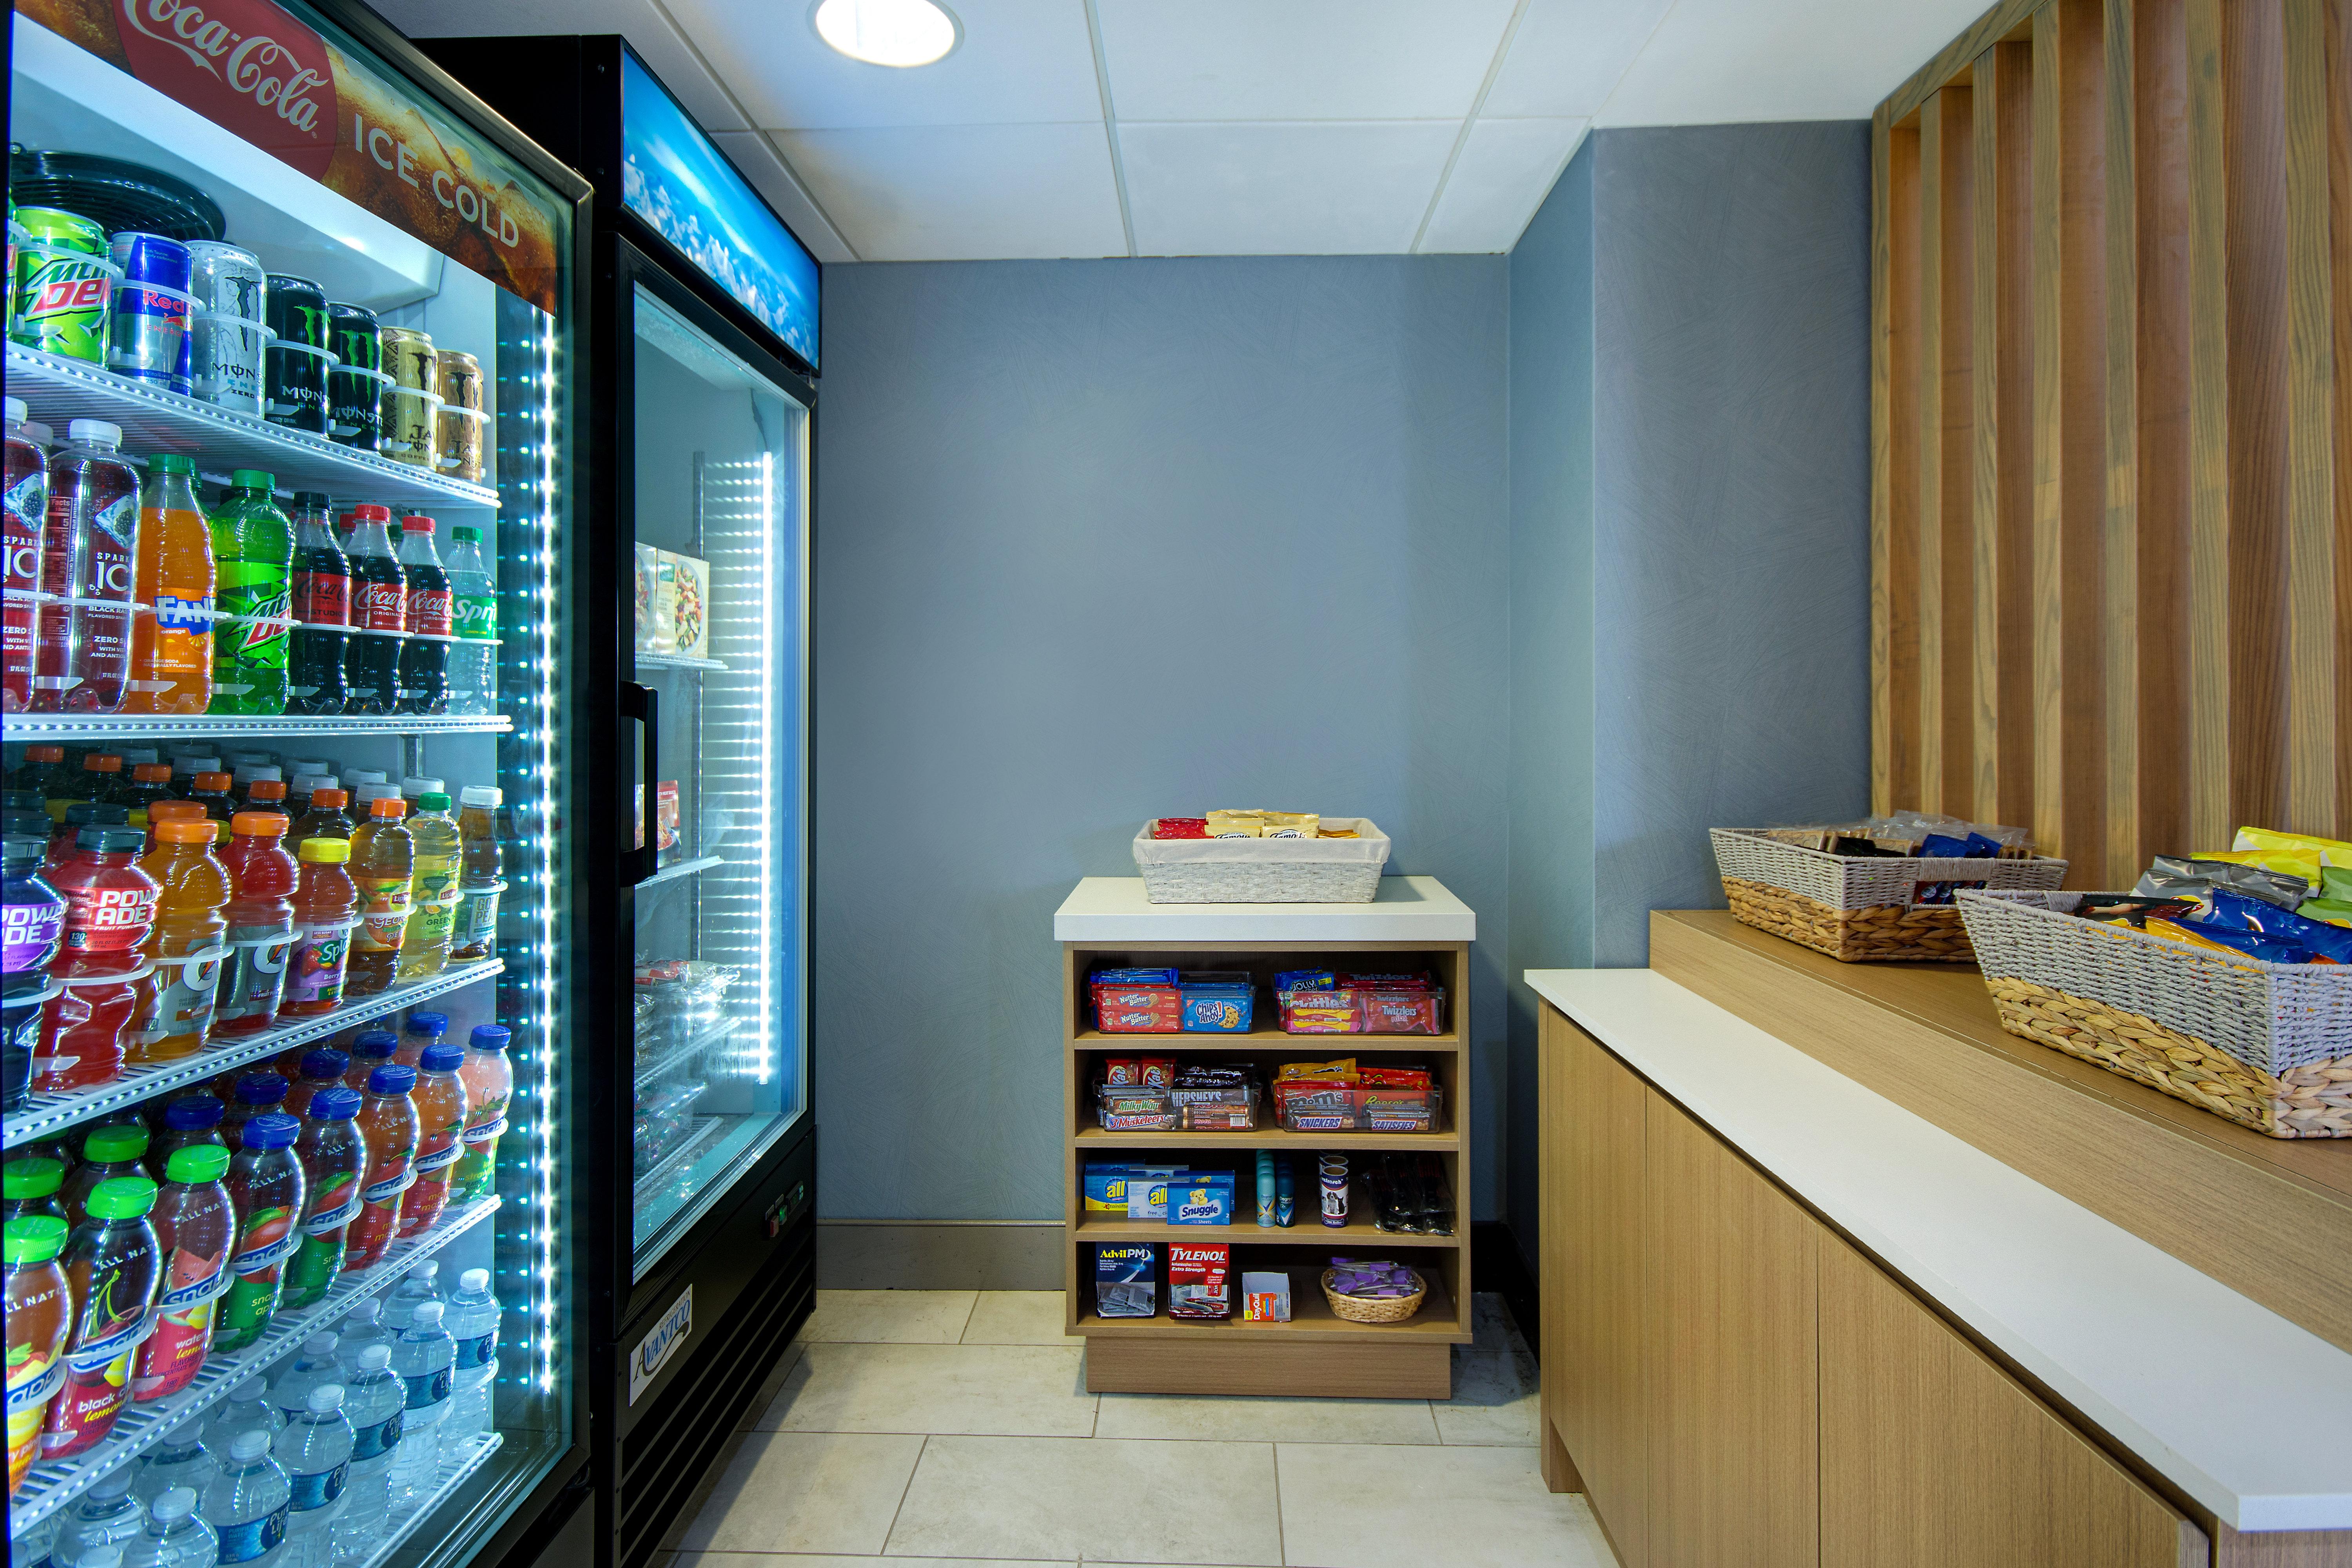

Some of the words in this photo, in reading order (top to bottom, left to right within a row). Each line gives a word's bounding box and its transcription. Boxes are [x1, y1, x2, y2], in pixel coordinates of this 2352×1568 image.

[354, 114, 420, 189] ICE
[433, 172, 520, 249] COLD
[143, 290, 184, 313] Red
[146, 370, 170, 379] Vitalizes
[231, 389, 255, 399] ZERO
[97, 552, 129, 563] SPARK
[96, 906, 147, 925] ADE
[71, 932, 85, 940] 130
[1293, 979, 1315, 991] JOLLY
[1120, 993, 1139, 1004] Nutter
[1130, 996, 1148, 1006] Butter
[1196, 1002, 1218, 1016] Chips
[1223, 1001, 1240, 1011] ORIGINAL
[1381, 1005, 1417, 1016] Twizzlers
[1121, 1012, 1140, 1023] Nutter
[1131, 1014, 1149, 1025] Butter
[1200, 1005, 1222, 1024] Ahoy!
[1112, 1069, 1129, 1085] Kat
[1148, 1069, 1165, 1089] Kat
[1172, 1091, 1222, 1107] HERSHEY'S
[1119, 1100, 1142, 1113] Milky
[1141, 1100, 1160, 1111] Way
[380, 1120, 398, 1131] ALL
[1111, 1118, 1119, 1129] 3
[1118, 1114, 1165, 1128] Musketeers
[1299, 1118, 1341, 1128] SNICKERS
[1372, 1121, 1415, 1129] SATISFIES
[326, 1144, 346, 1156] ALL
[253, 1177, 274, 1189] ALL
[1106, 1181, 1126, 1198] all
[1150, 1187, 1167, 1205] all
[181, 1210, 201, 1223] ALL
[1182, 1204, 1218, 1217] Snuggle
[1100, 1249, 1127, 1258] Advil
[1127, 1249, 1145, 1258] PM
[1171, 1248, 1225, 1261] TYLENOL
[99, 1254, 123, 1271] ALL
[659, 1292, 690, 1331] REFRIGERATION
[1252, 1294, 1262, 1320] DayQuil
[633, 1299, 691, 1383] AVANTCO
[78, 1390, 115, 1413] black
[229, 1524, 253, 1534] PURIFIED
